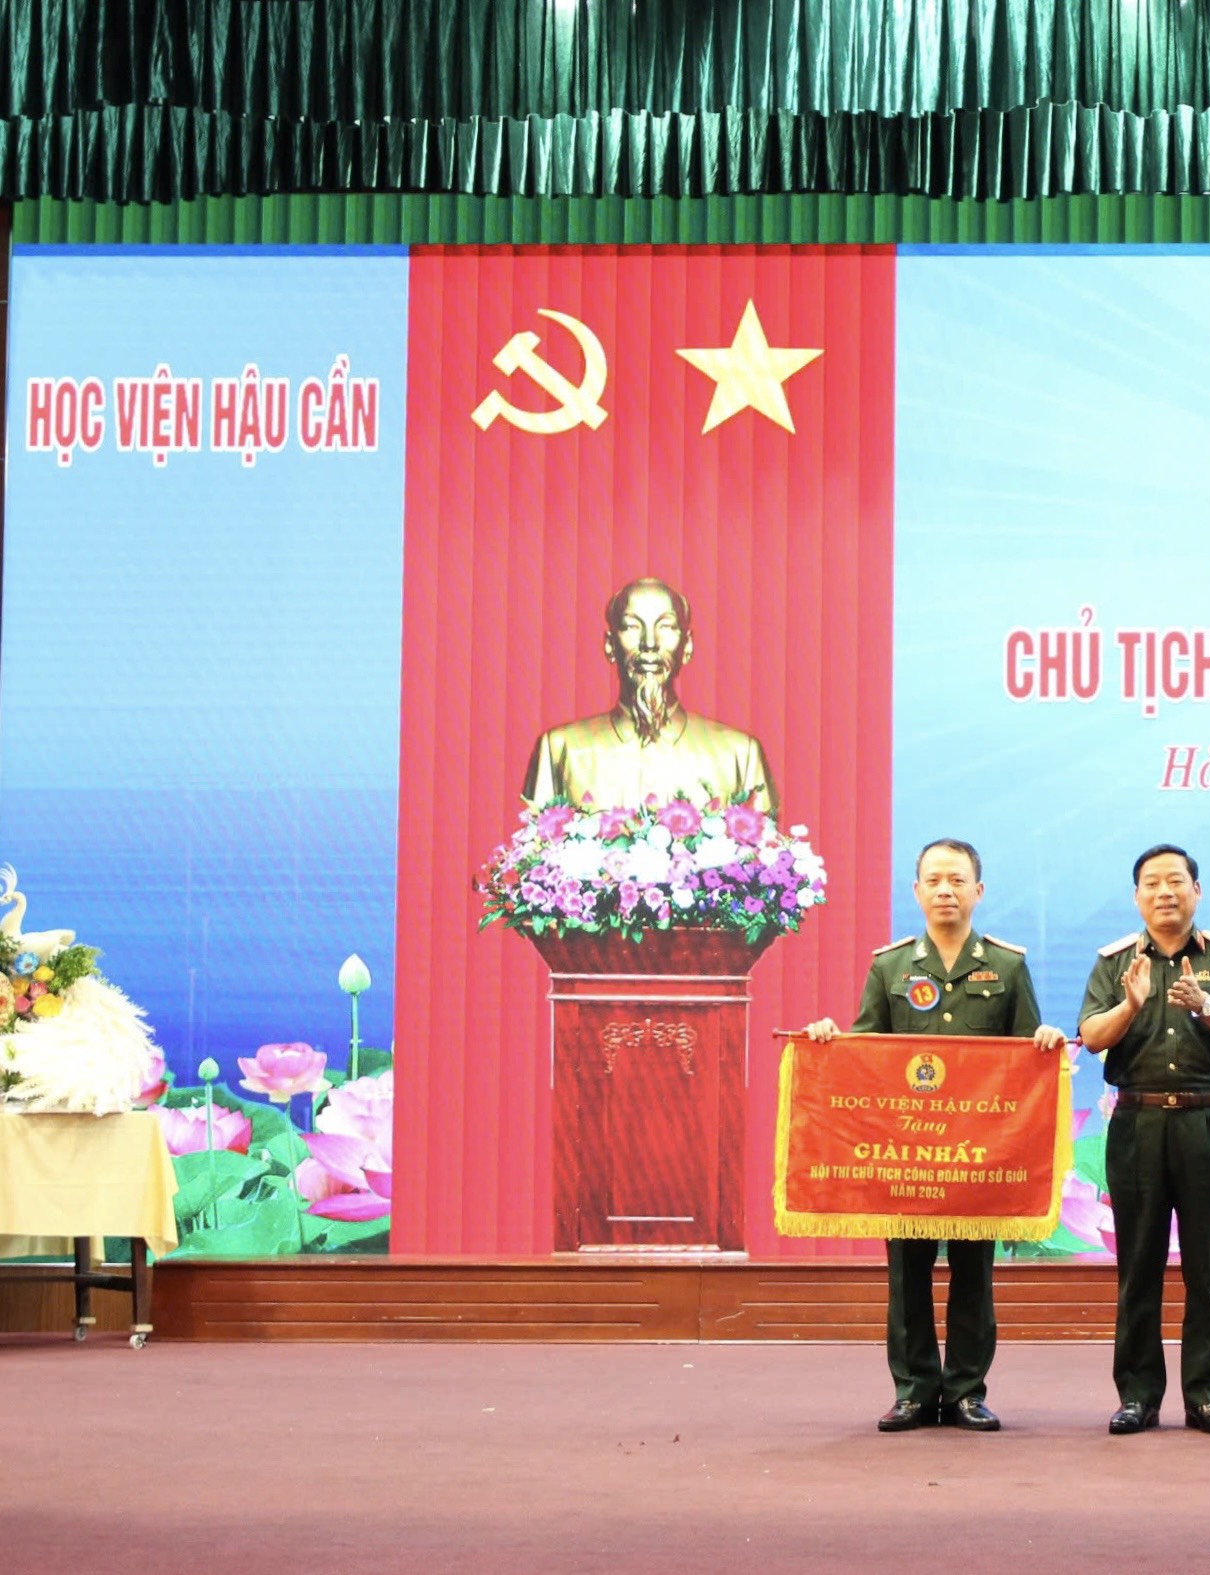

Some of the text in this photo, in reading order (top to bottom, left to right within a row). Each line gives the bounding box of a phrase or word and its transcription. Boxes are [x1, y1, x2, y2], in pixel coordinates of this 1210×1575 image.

[28, 355, 378, 465] HỌC VIỆN HẬU CẦN
[1004, 606, 1101, 700] CHỦ
[914, 985, 933, 1004] 13
[830, 1096, 872, 1111] HỌC
[877, 1095, 924, 1114] VIỆN
[929, 1096, 972, 1115] HẬU
[899, 1115, 947, 1135] Tặng
[854, 1138, 988, 1163] GIẢI NHẤT
[810, 1162, 830, 1181] HỘI
[832, 1165, 850, 1179] THI
[852, 1162, 875, 1179] CHỦ
[877, 1166, 902, 1182] TỊCH
[904, 1166, 935, 1182] CÔNG
[918, 1186, 946, 1199] 2024
